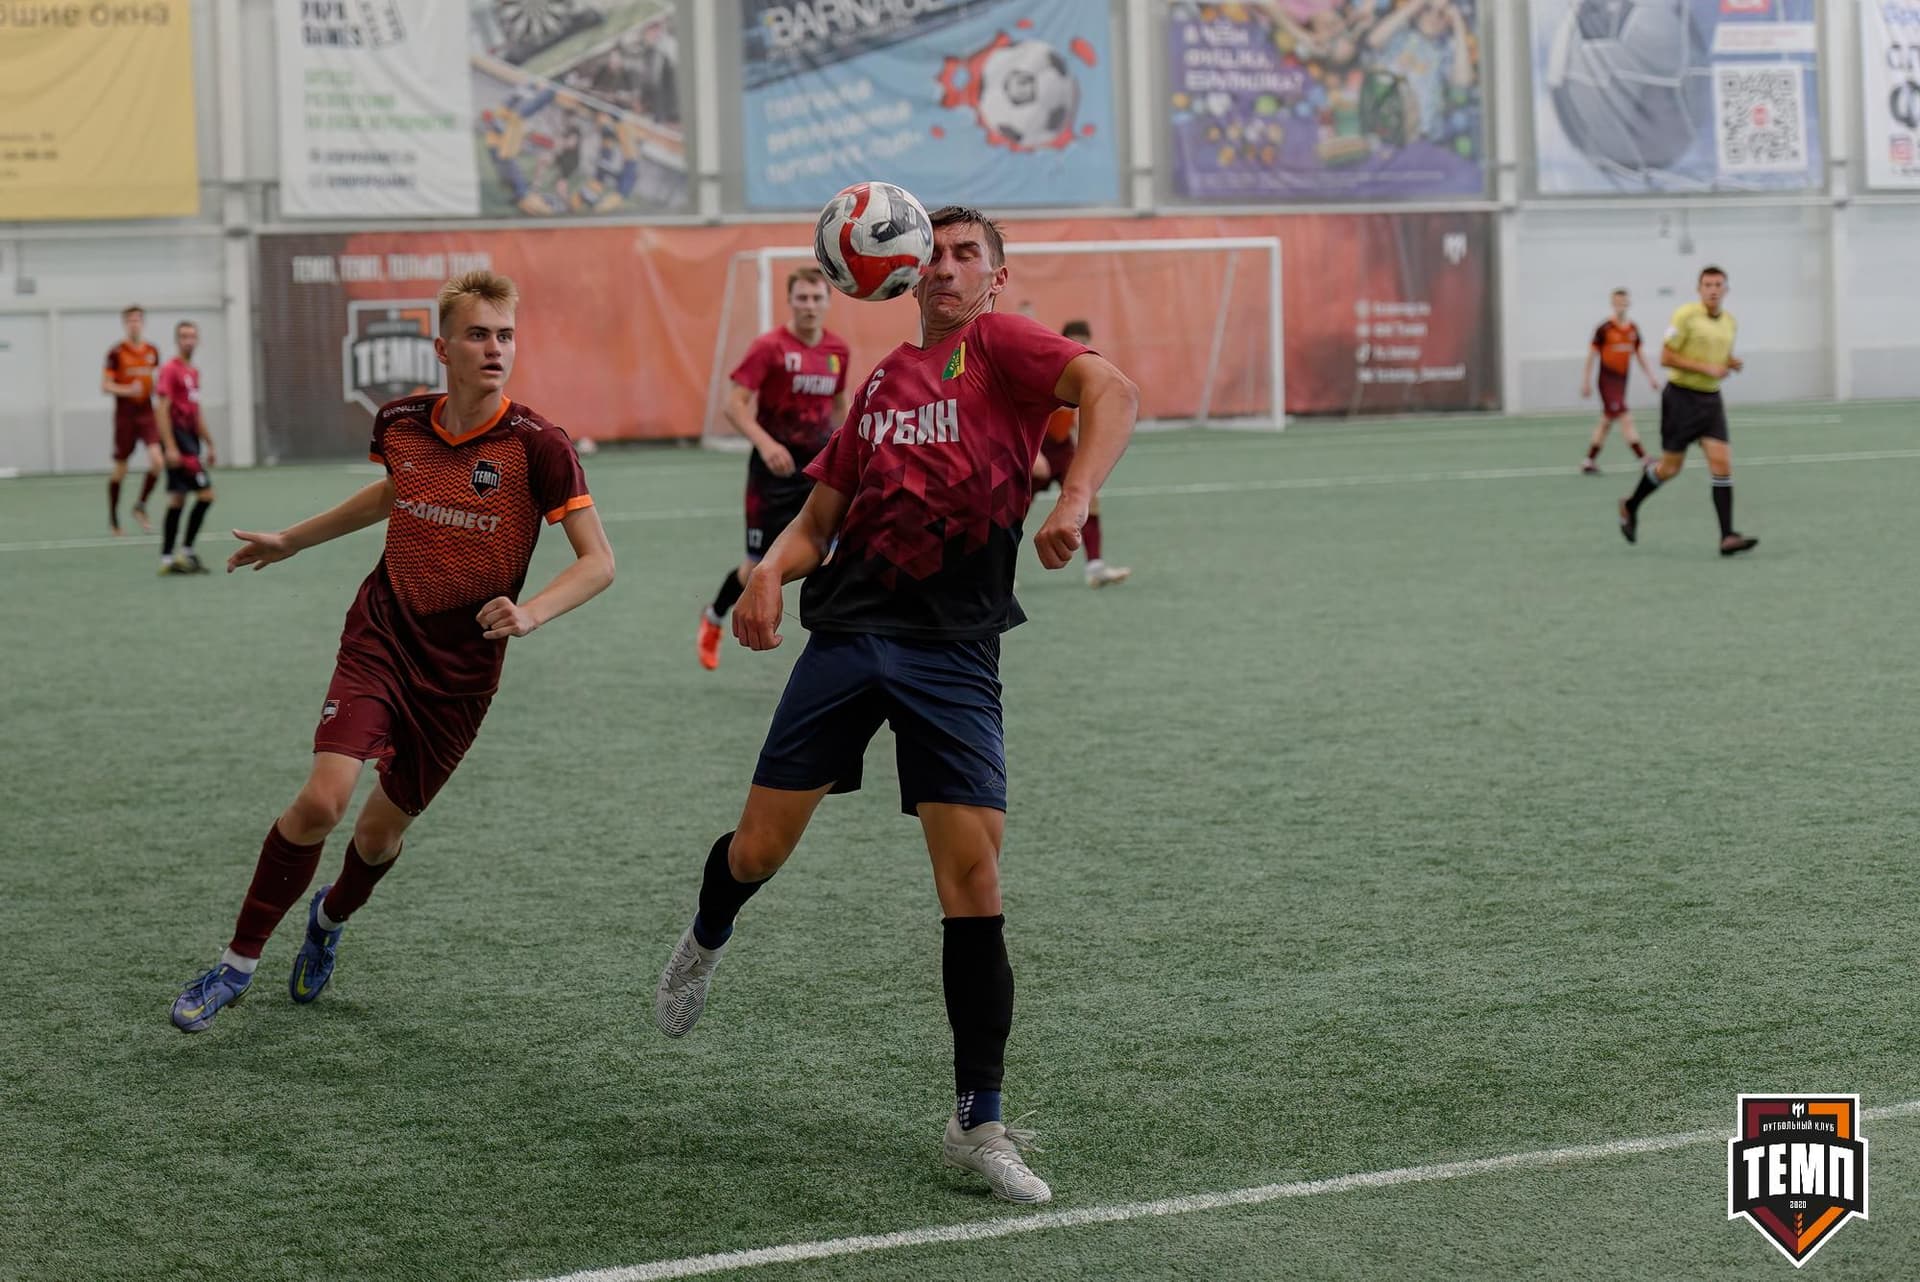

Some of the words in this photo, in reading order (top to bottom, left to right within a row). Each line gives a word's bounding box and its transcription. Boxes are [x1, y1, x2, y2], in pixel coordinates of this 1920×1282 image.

[89, 4, 169, 27] окна
[353, 335, 438, 387] ТЕМП
[475, 470, 498, 487] ТЕМП
